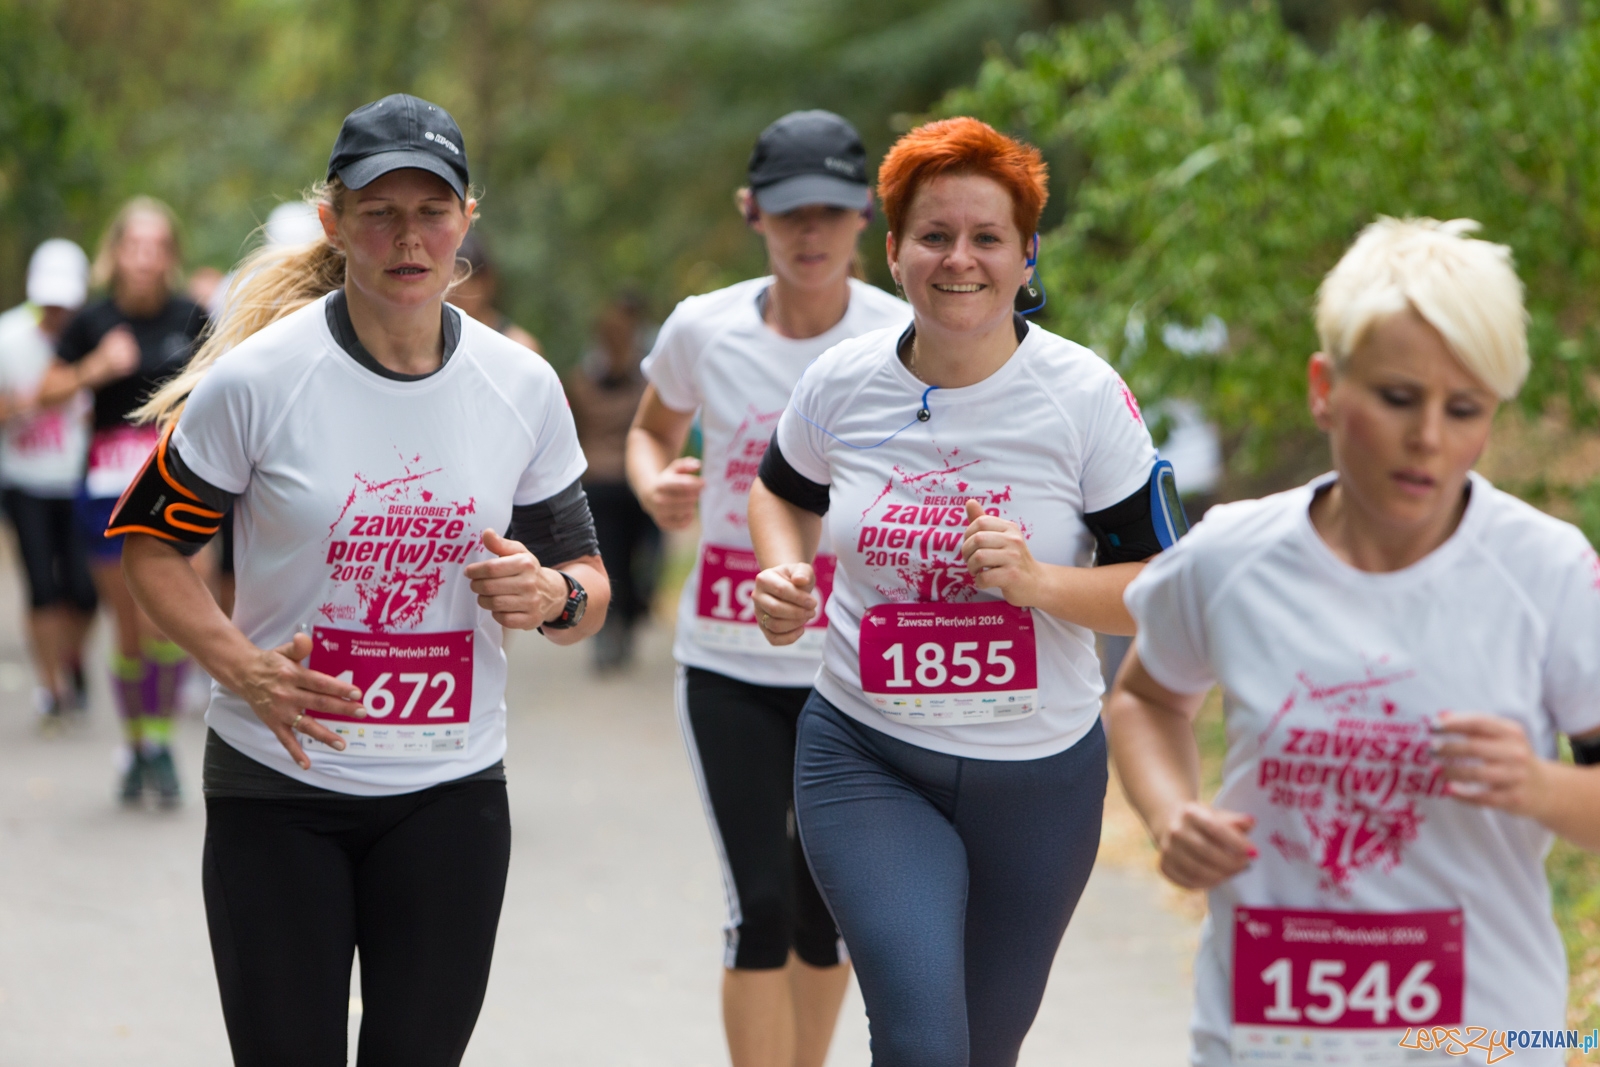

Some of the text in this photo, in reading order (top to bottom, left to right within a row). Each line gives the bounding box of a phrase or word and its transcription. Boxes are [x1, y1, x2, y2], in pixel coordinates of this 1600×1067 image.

[923, 496, 987, 506] BIEG KOBET
[388, 505, 453, 518] BIEG KOBIET
[349, 515, 465, 540] zawsze
[326, 538, 475, 572] pier(w)si!
[865, 551, 910, 567] 2016
[330, 564, 375, 582] 2016
[897, 617, 933, 627] Zawsze
[935, 616, 976, 628] Pier(w)si
[978, 615, 1004, 625] 2016
[350, 644, 387, 657] Zawsze
[389, 646, 427, 659] Pier(w)si
[428, 645, 450, 657] 2016
[882, 640, 1016, 688] 1855
[1260, 957, 1442, 1025] 1546
